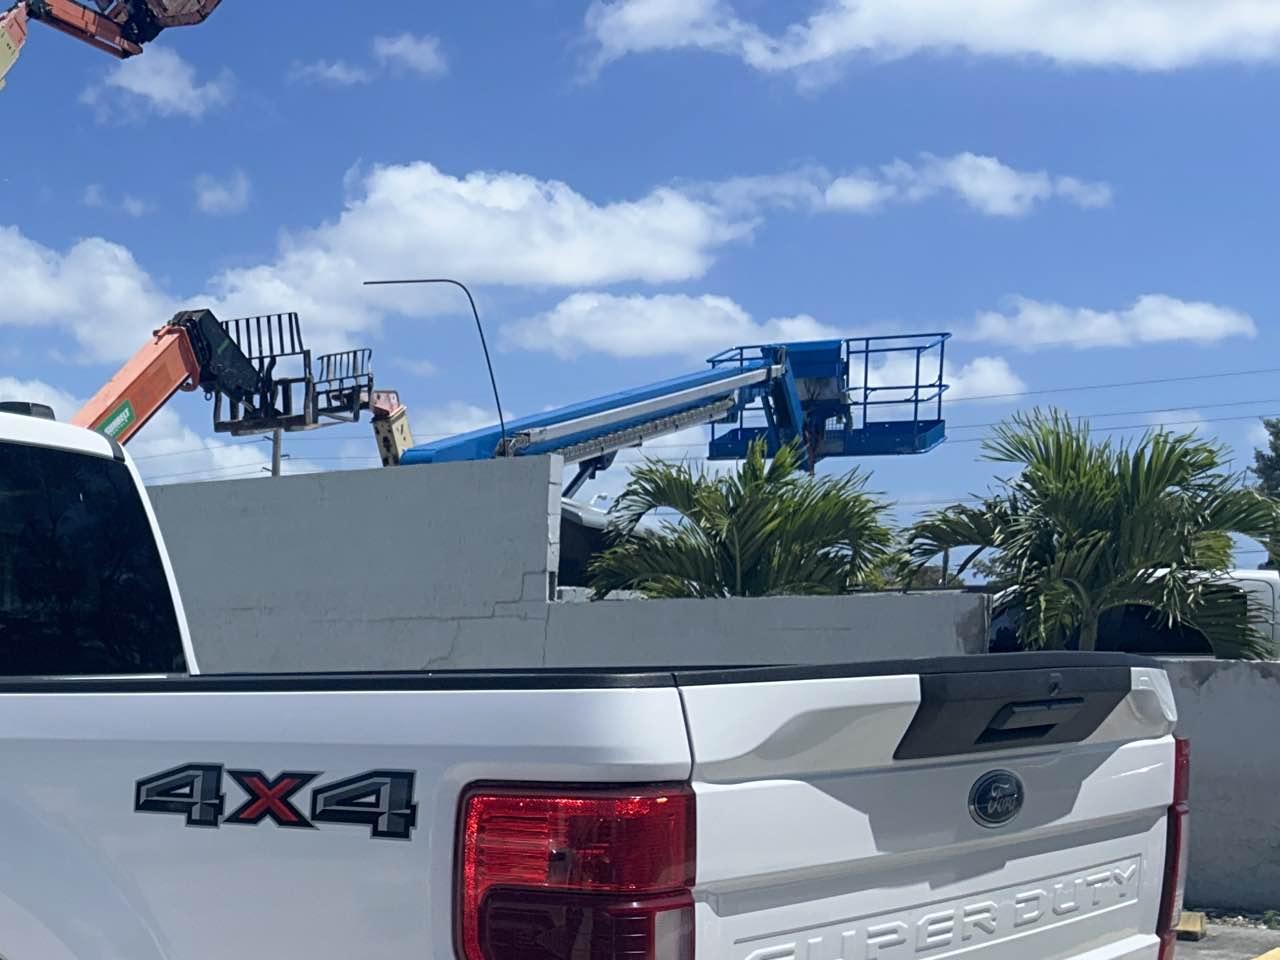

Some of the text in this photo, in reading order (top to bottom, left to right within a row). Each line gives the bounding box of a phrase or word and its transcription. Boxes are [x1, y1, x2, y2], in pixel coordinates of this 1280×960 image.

[133, 761, 419, 842] 4X4
[987, 783, 1017, 814] Ford
[1012, 863, 1138, 929] DUTY
